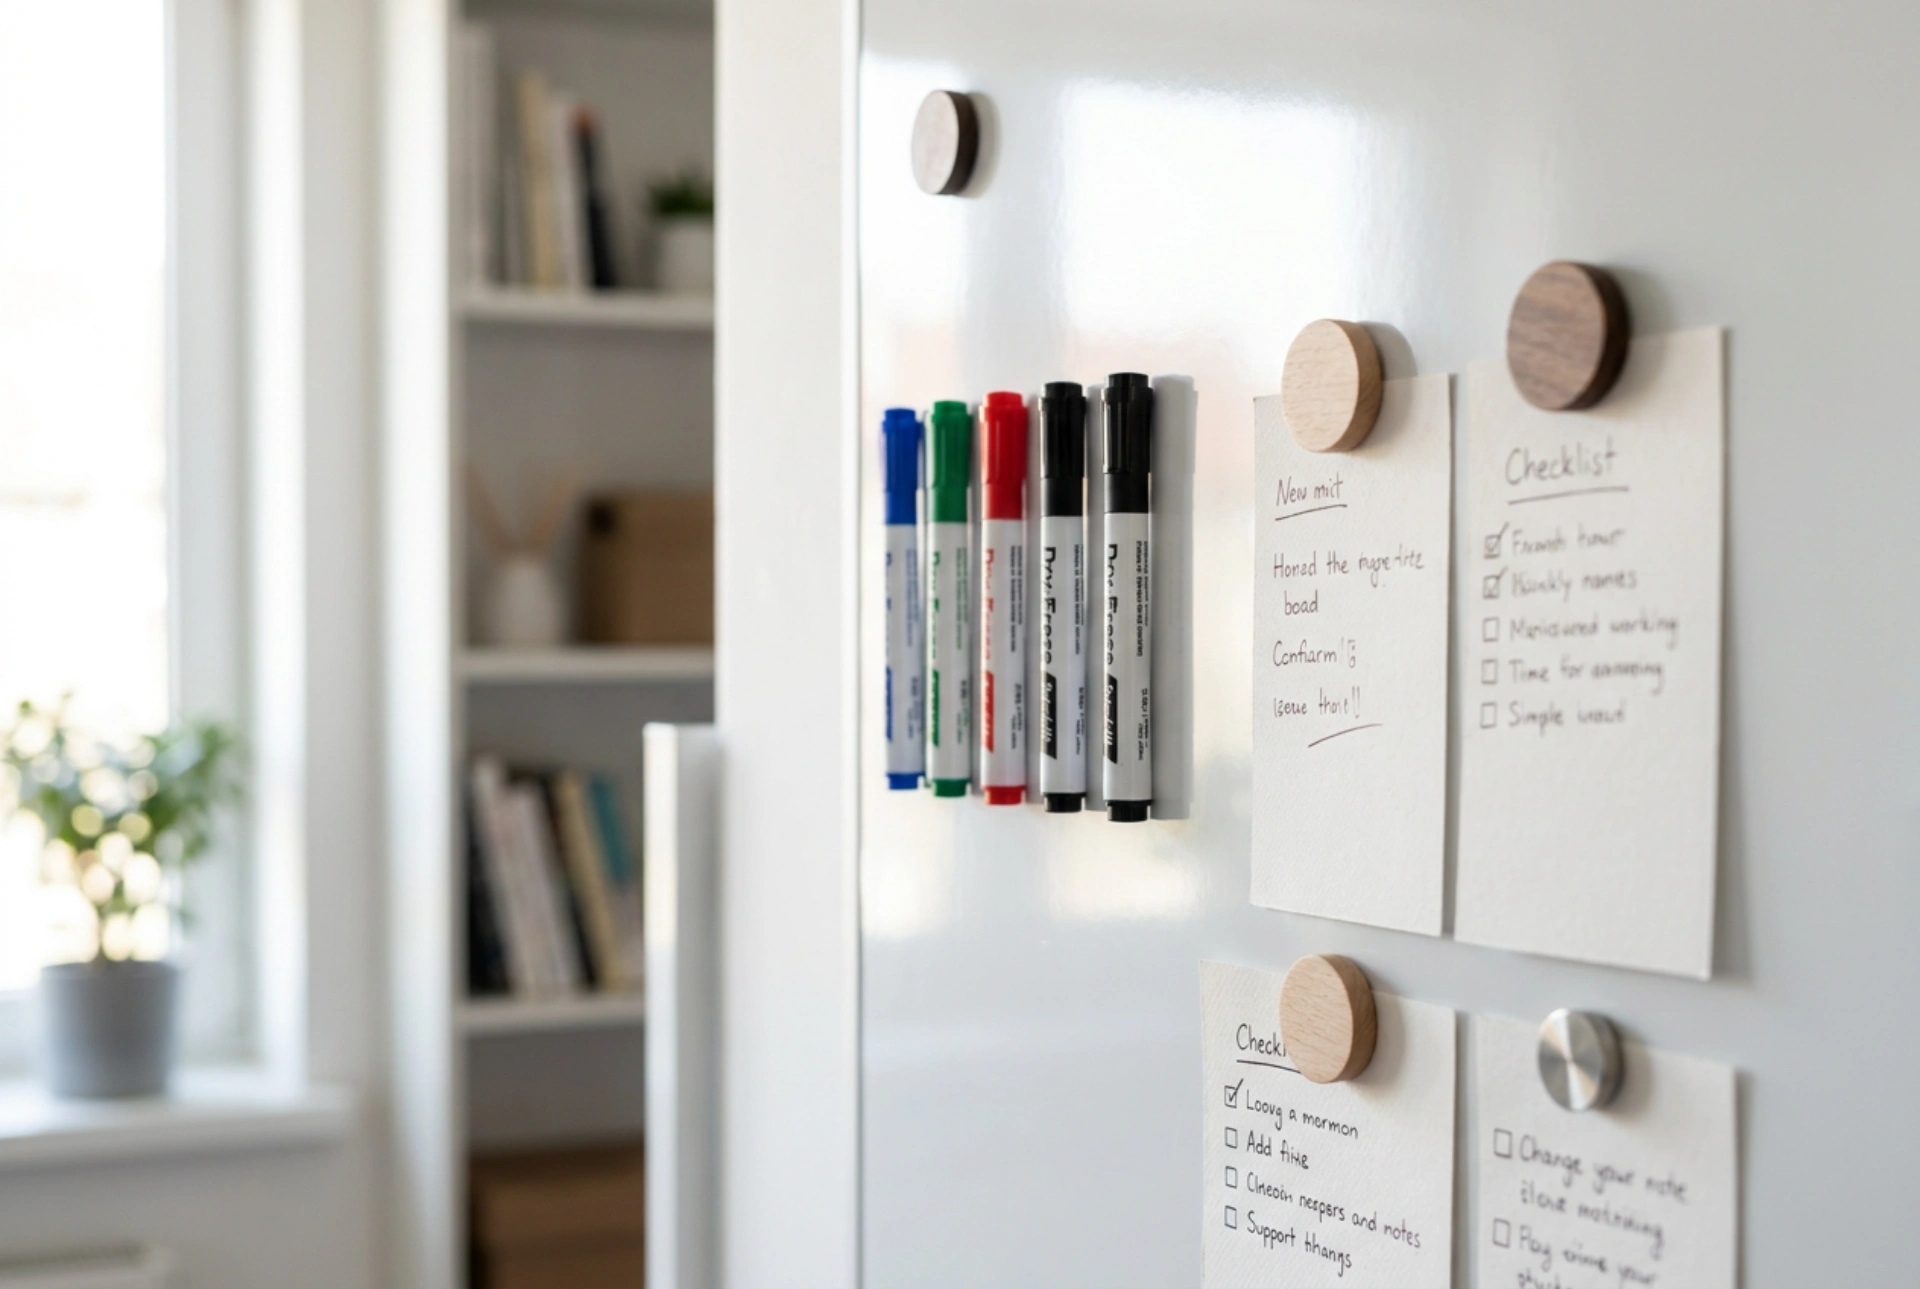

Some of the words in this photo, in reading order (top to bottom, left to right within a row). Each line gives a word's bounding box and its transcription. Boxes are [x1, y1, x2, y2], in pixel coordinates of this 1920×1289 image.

[1505, 436, 1616, 486] Checklist
[1326, 550, 1350, 575] the
[1508, 659, 1550, 684] Time
[1560, 653, 1584, 680] for
[1508, 700, 1565, 738] Simple
[1289, 1108, 1298, 1122] a
[1246, 1130, 1272, 1157] Add
[1246, 1210, 1297, 1250] Support
[1351, 1211, 1378, 1232] and
[1383, 1218, 1422, 1249] notes
